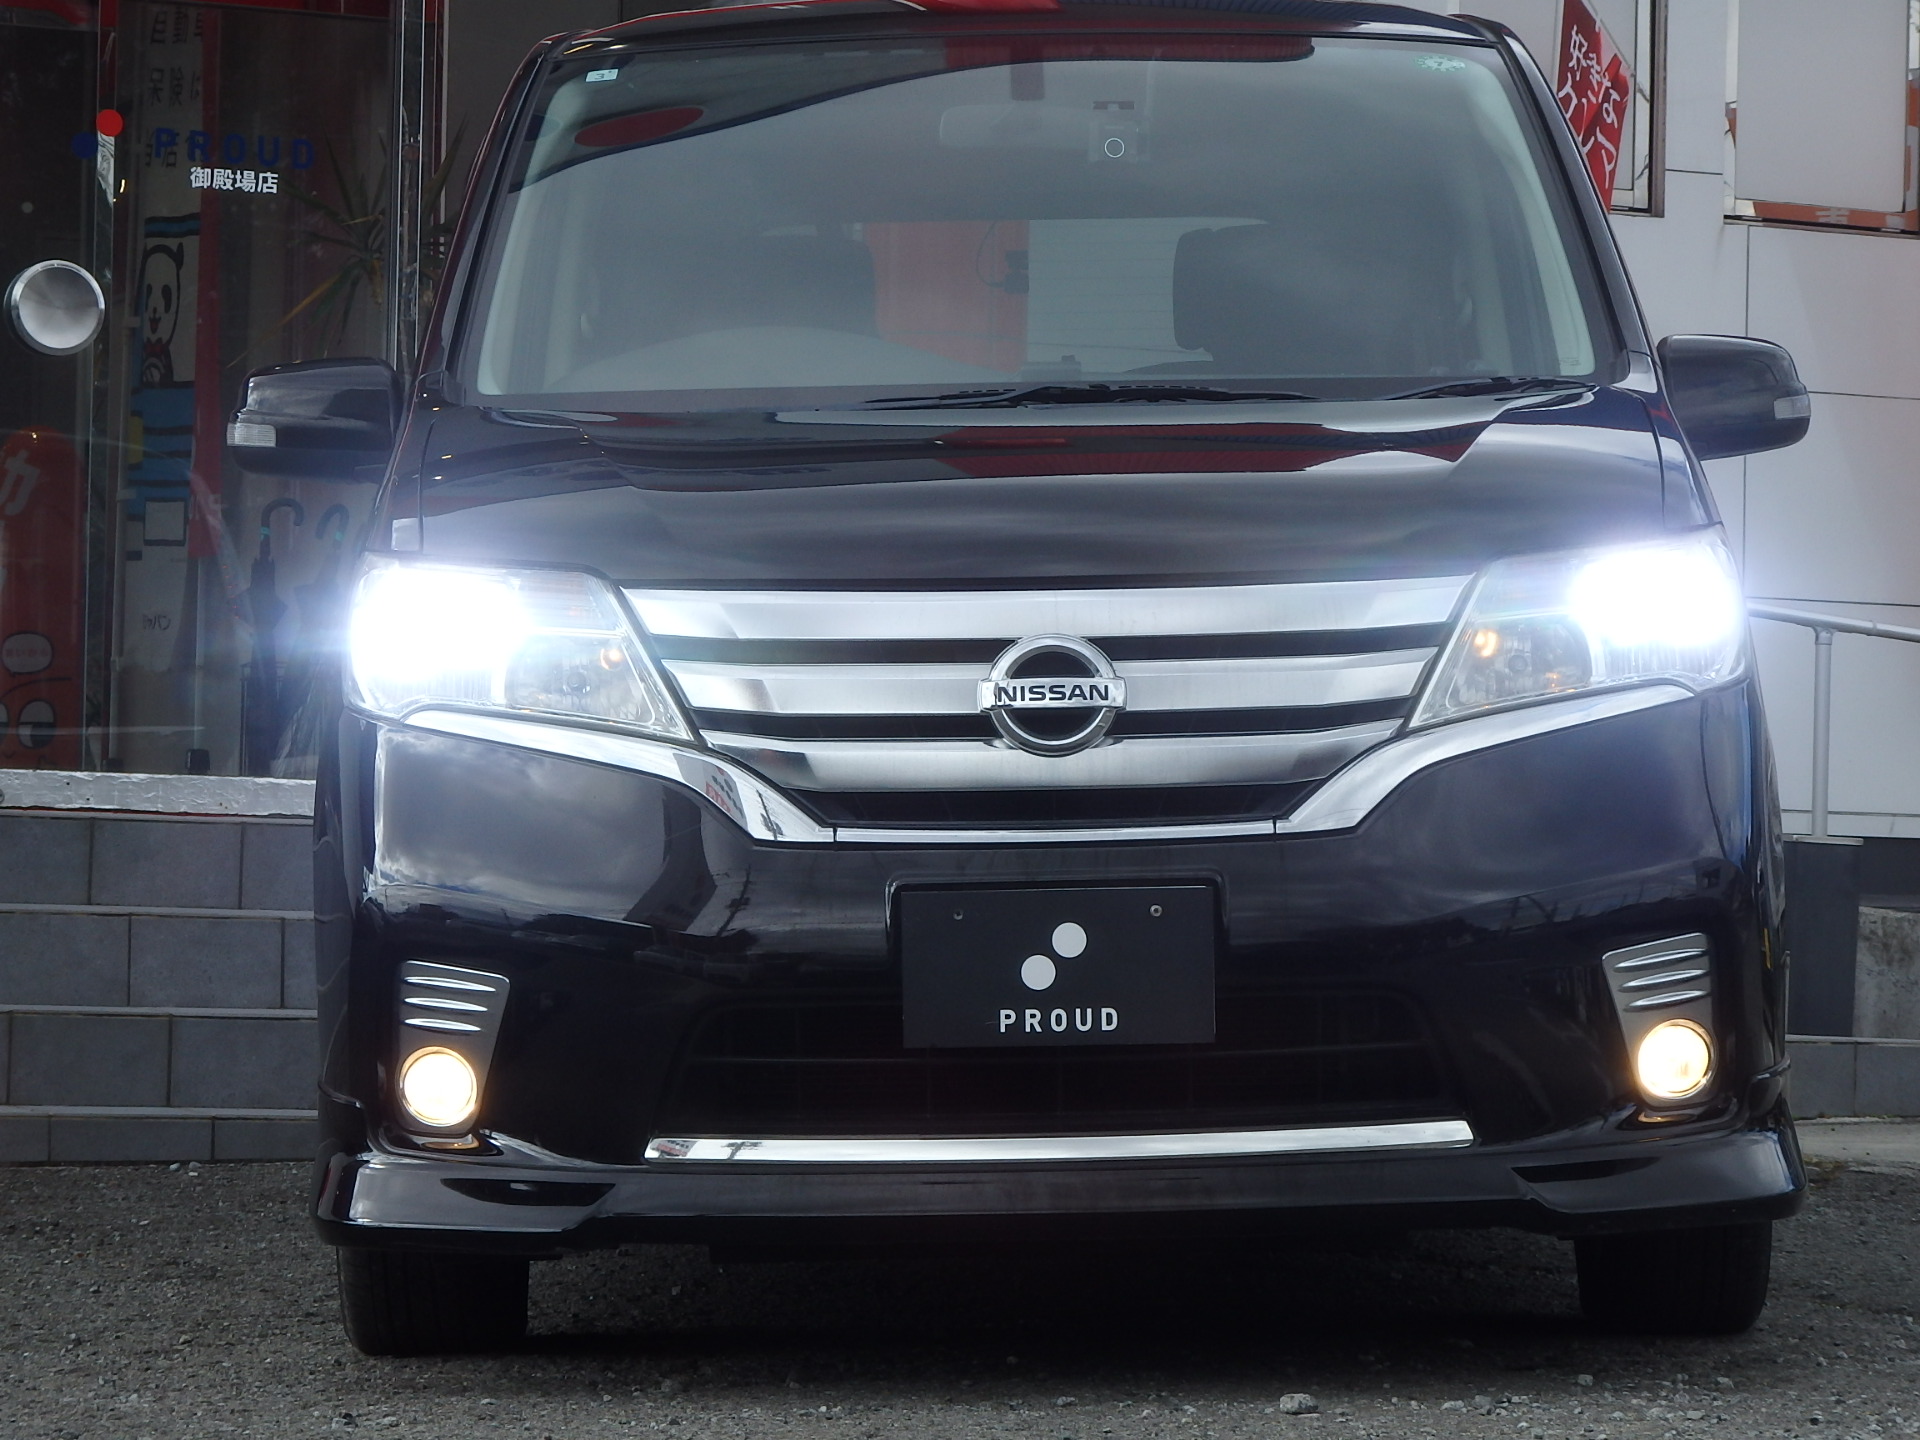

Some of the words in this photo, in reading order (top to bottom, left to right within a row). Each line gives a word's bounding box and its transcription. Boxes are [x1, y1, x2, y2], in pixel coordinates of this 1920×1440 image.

[154, 127, 315, 170] PROUD
[190, 166, 279, 194] 御殿場店
[997, 684, 1109, 702] NISSAN
[999, 1007, 1120, 1033] PROUD
